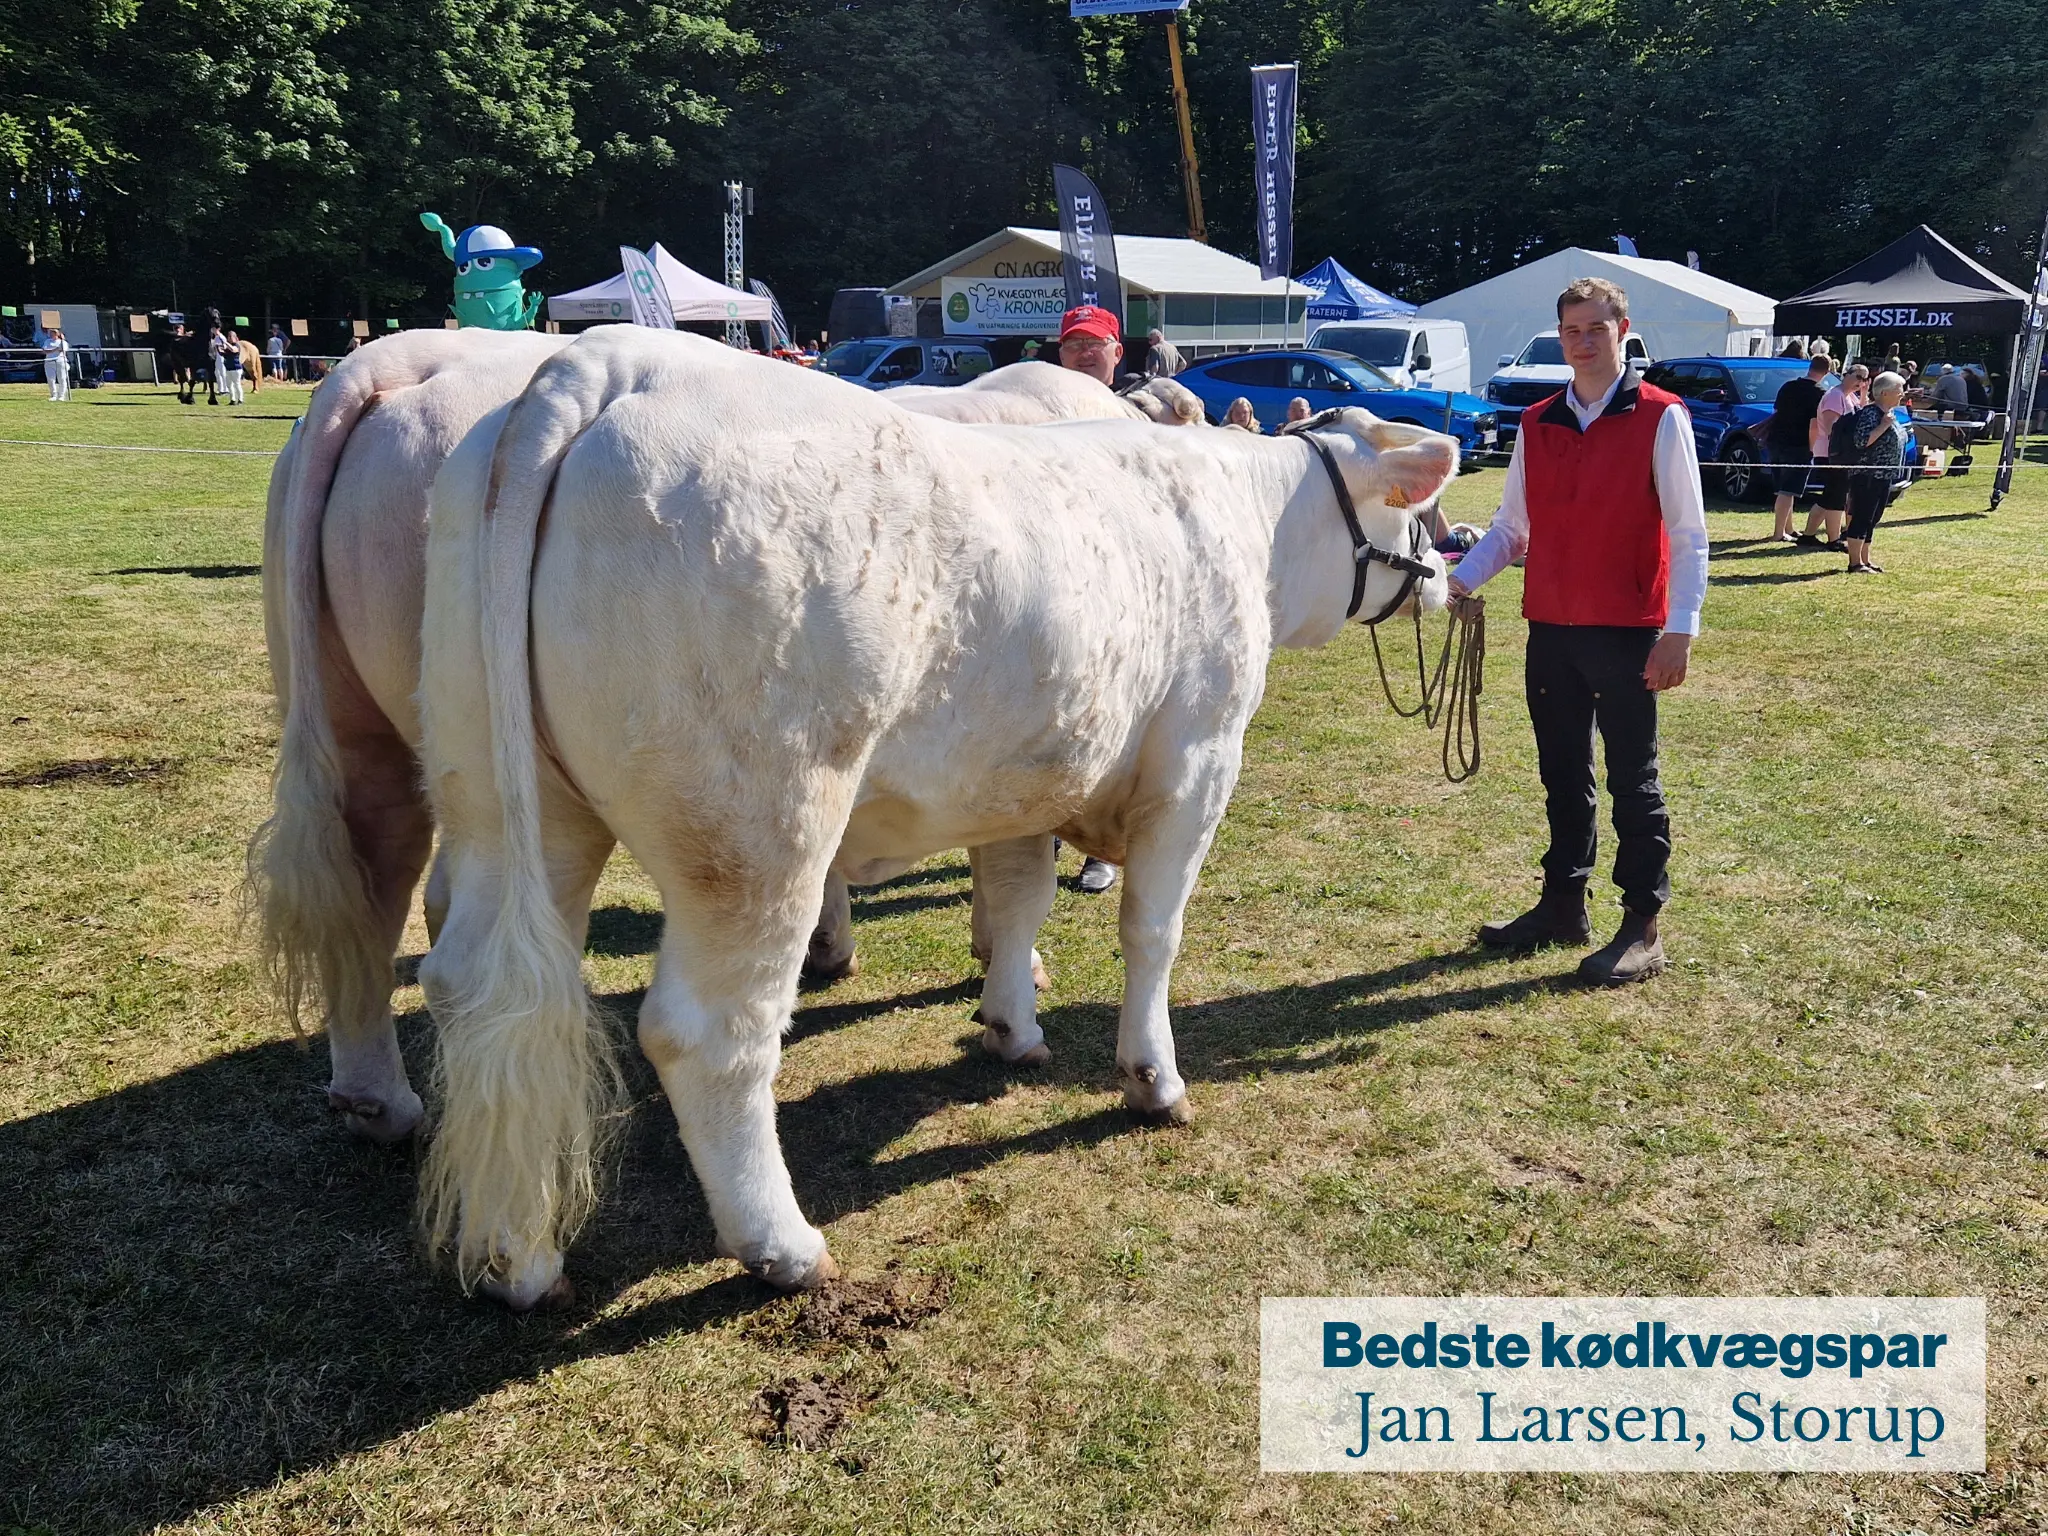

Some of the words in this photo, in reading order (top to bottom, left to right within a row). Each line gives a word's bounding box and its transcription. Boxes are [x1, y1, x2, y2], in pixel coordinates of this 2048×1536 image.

[1266, 83, 1279, 163] EJNER
[1266, 171, 1278, 264] HESSEL
[994, 262, 1017, 279] CN
[1004, 300, 1066, 314] KRONBO
[1835, 308, 1954, 328] HESSEL.DK
